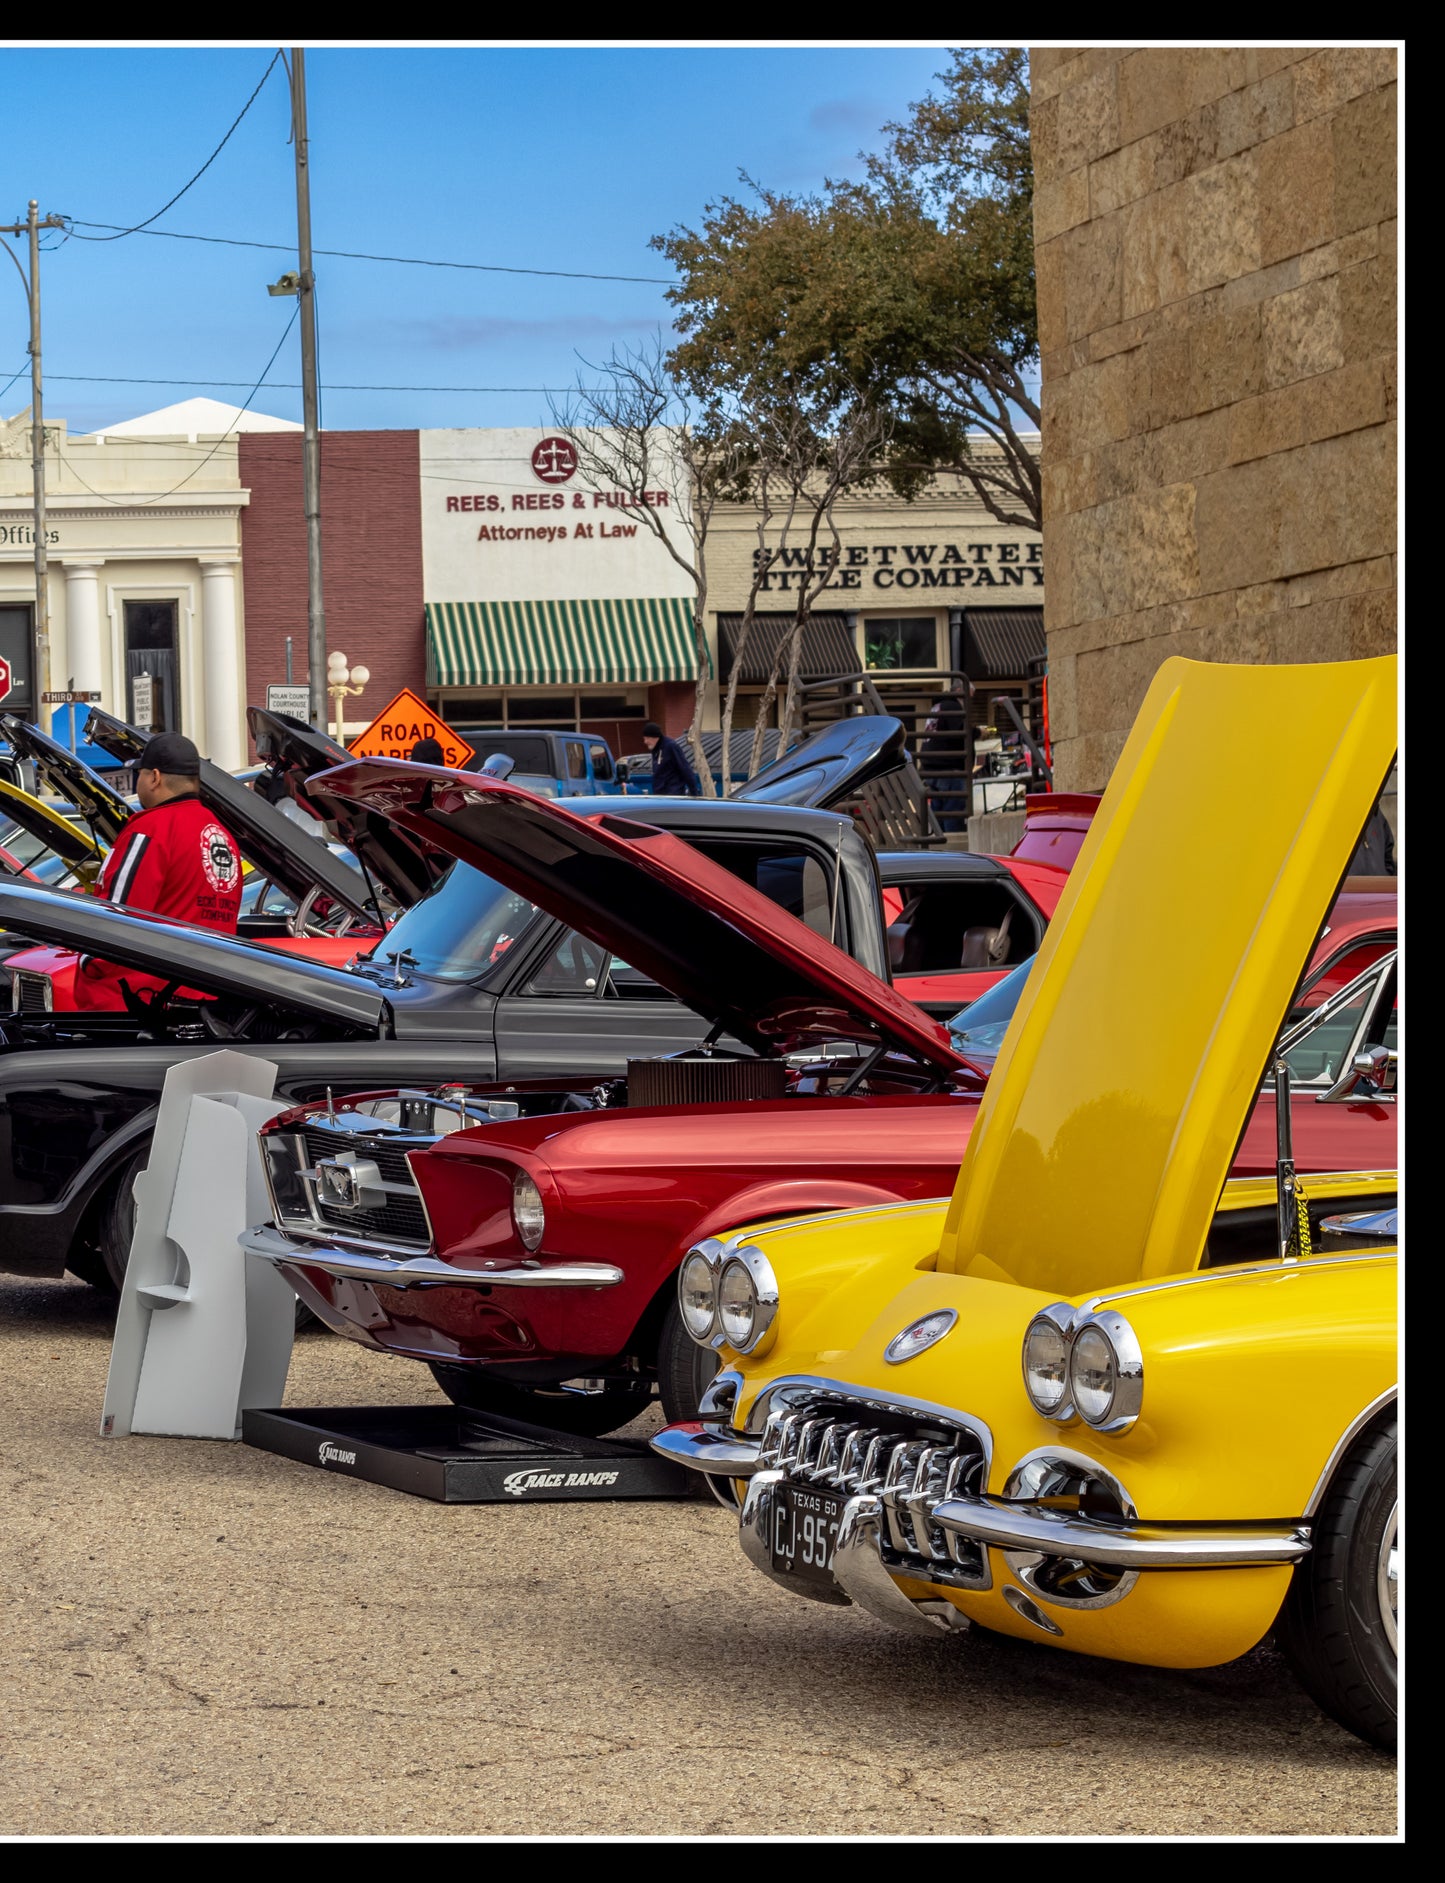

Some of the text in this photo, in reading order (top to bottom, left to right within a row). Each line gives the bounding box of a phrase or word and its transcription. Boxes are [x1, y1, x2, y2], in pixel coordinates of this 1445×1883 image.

[446, 494, 505, 512] REES,
[512, 493, 565, 510] REES
[572, 492, 586, 509] &
[478, 521, 637, 542] Attorneys At Law
[752, 543, 1043, 568] SWEETWATER
[872, 566, 1044, 588] COMPANY
[45, 692, 73, 703] THIRD
[272, 700, 307, 708] COURTHOUSE
[381, 723, 436, 741] ROAD
[524, 1471, 619, 1488] RACE RAMPS
[792, 1491, 837, 1516] TEXAS 60
